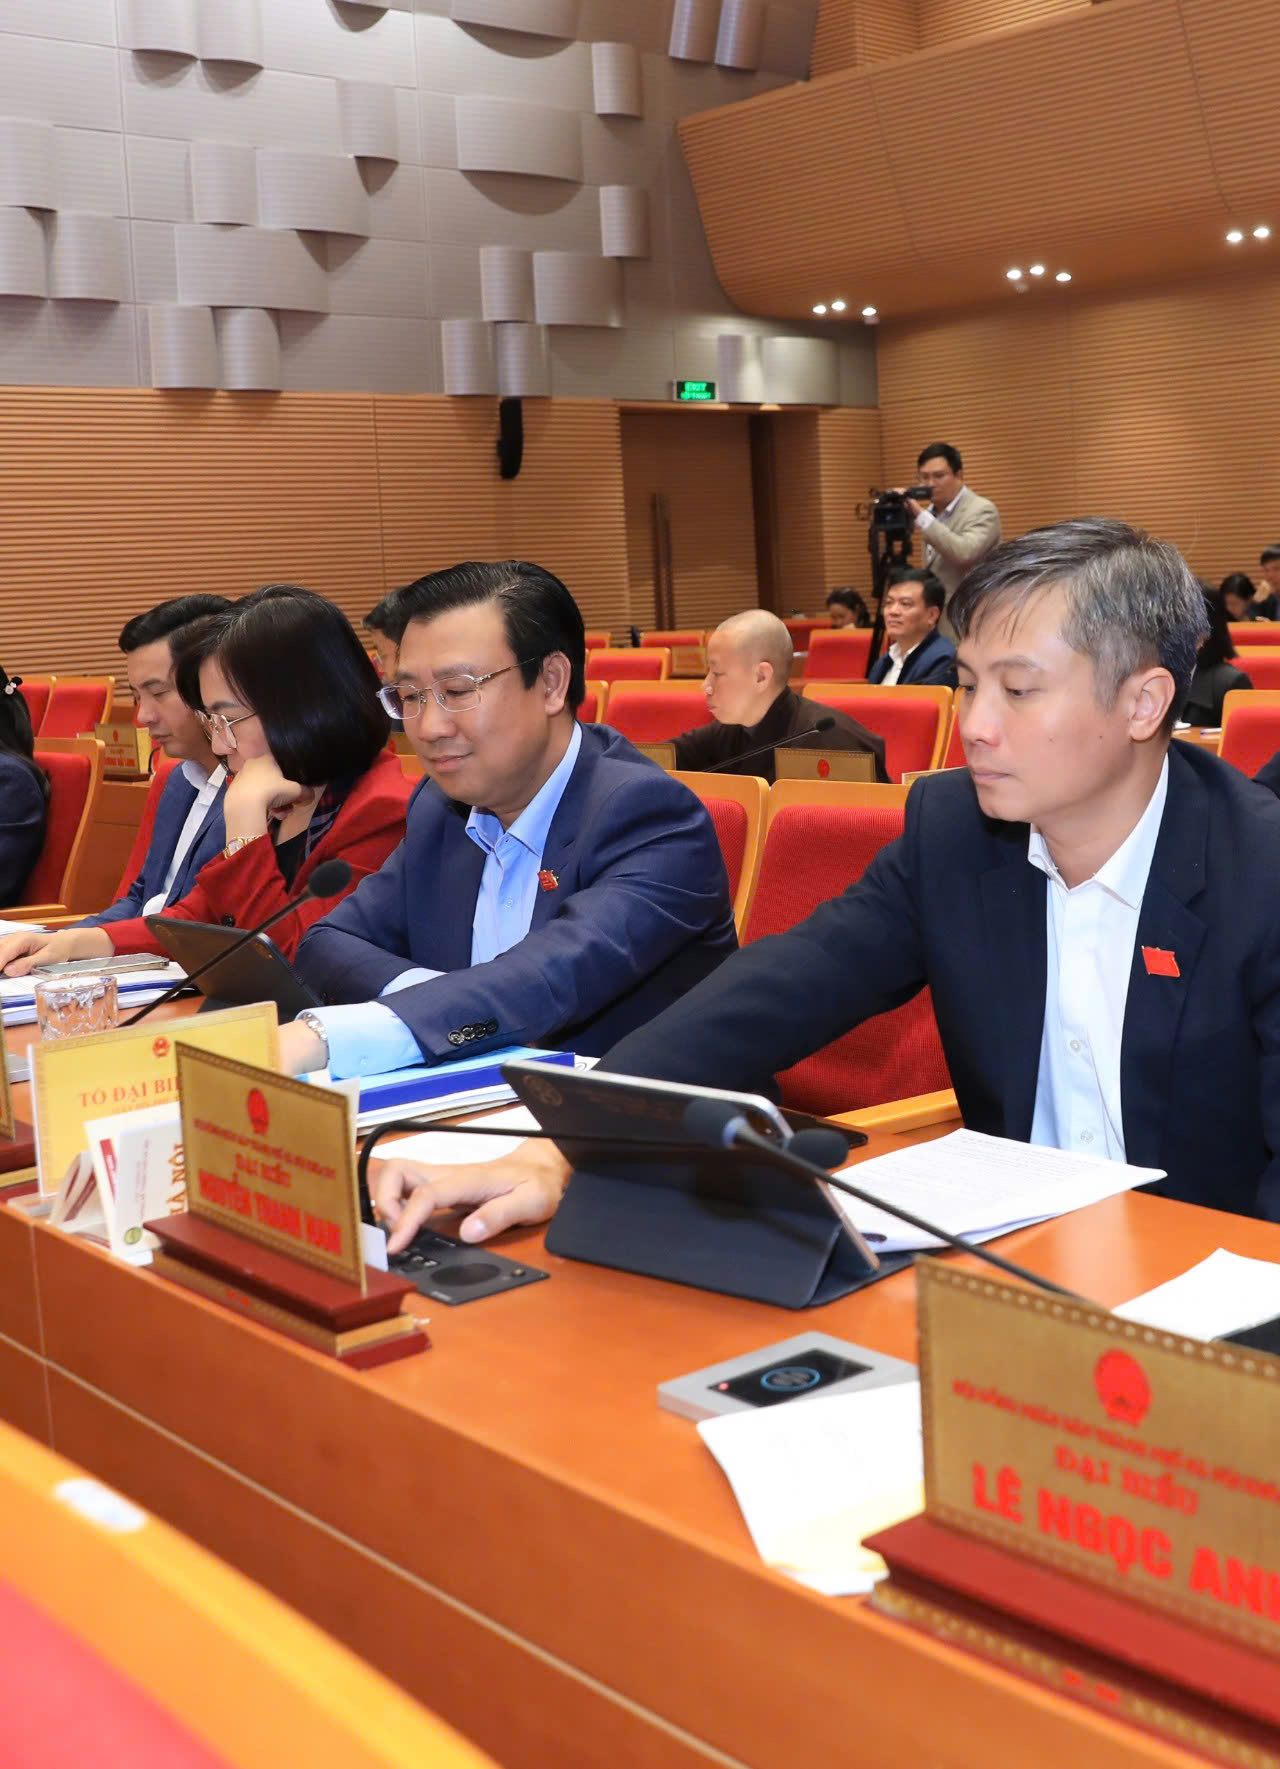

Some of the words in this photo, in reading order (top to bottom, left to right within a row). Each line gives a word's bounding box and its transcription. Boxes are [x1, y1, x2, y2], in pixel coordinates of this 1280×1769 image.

[1055, 1444, 1111, 1487] ĐẠI
[972, 1462, 1024, 1523] LÊ
[1037, 1487, 1173, 1576] NGỌC
